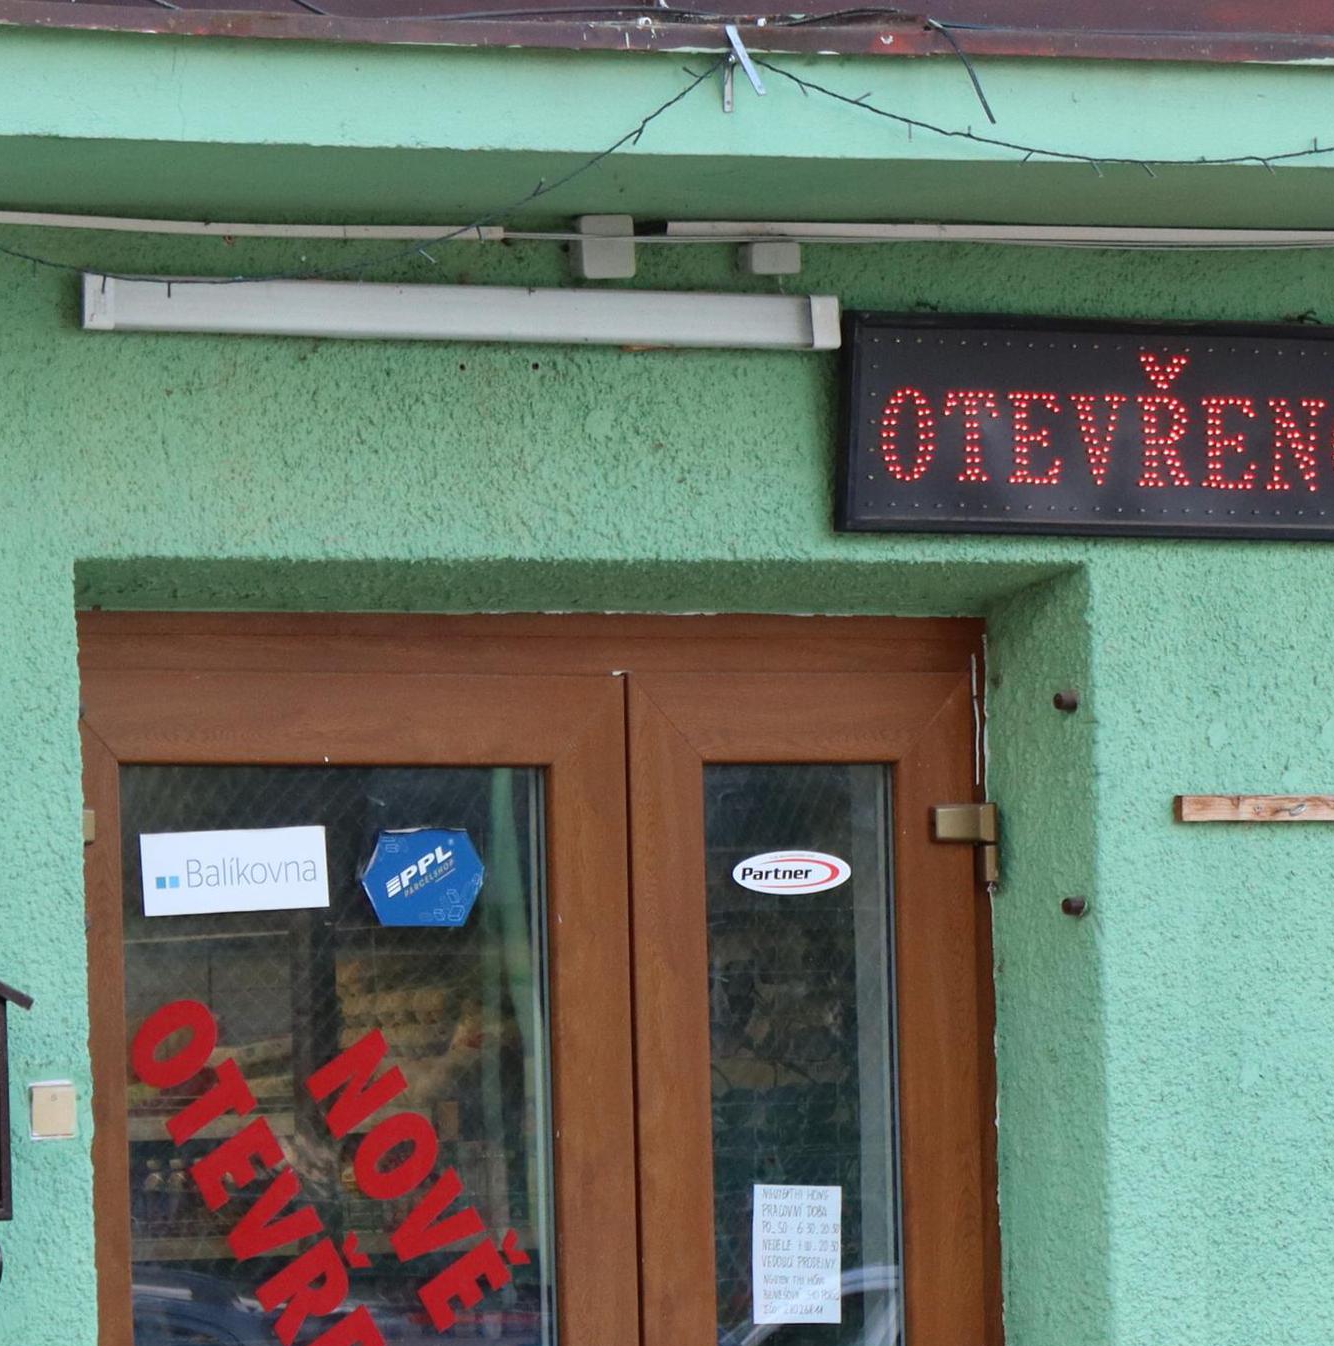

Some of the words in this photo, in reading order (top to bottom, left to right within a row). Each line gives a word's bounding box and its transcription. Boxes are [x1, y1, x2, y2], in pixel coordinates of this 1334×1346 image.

[186, 857, 317, 889] Balíkovna
[399, 846, 452, 889] PPL
[741, 867, 812, 881] Partner
[305, 1028, 530, 1333] NOVĚ
